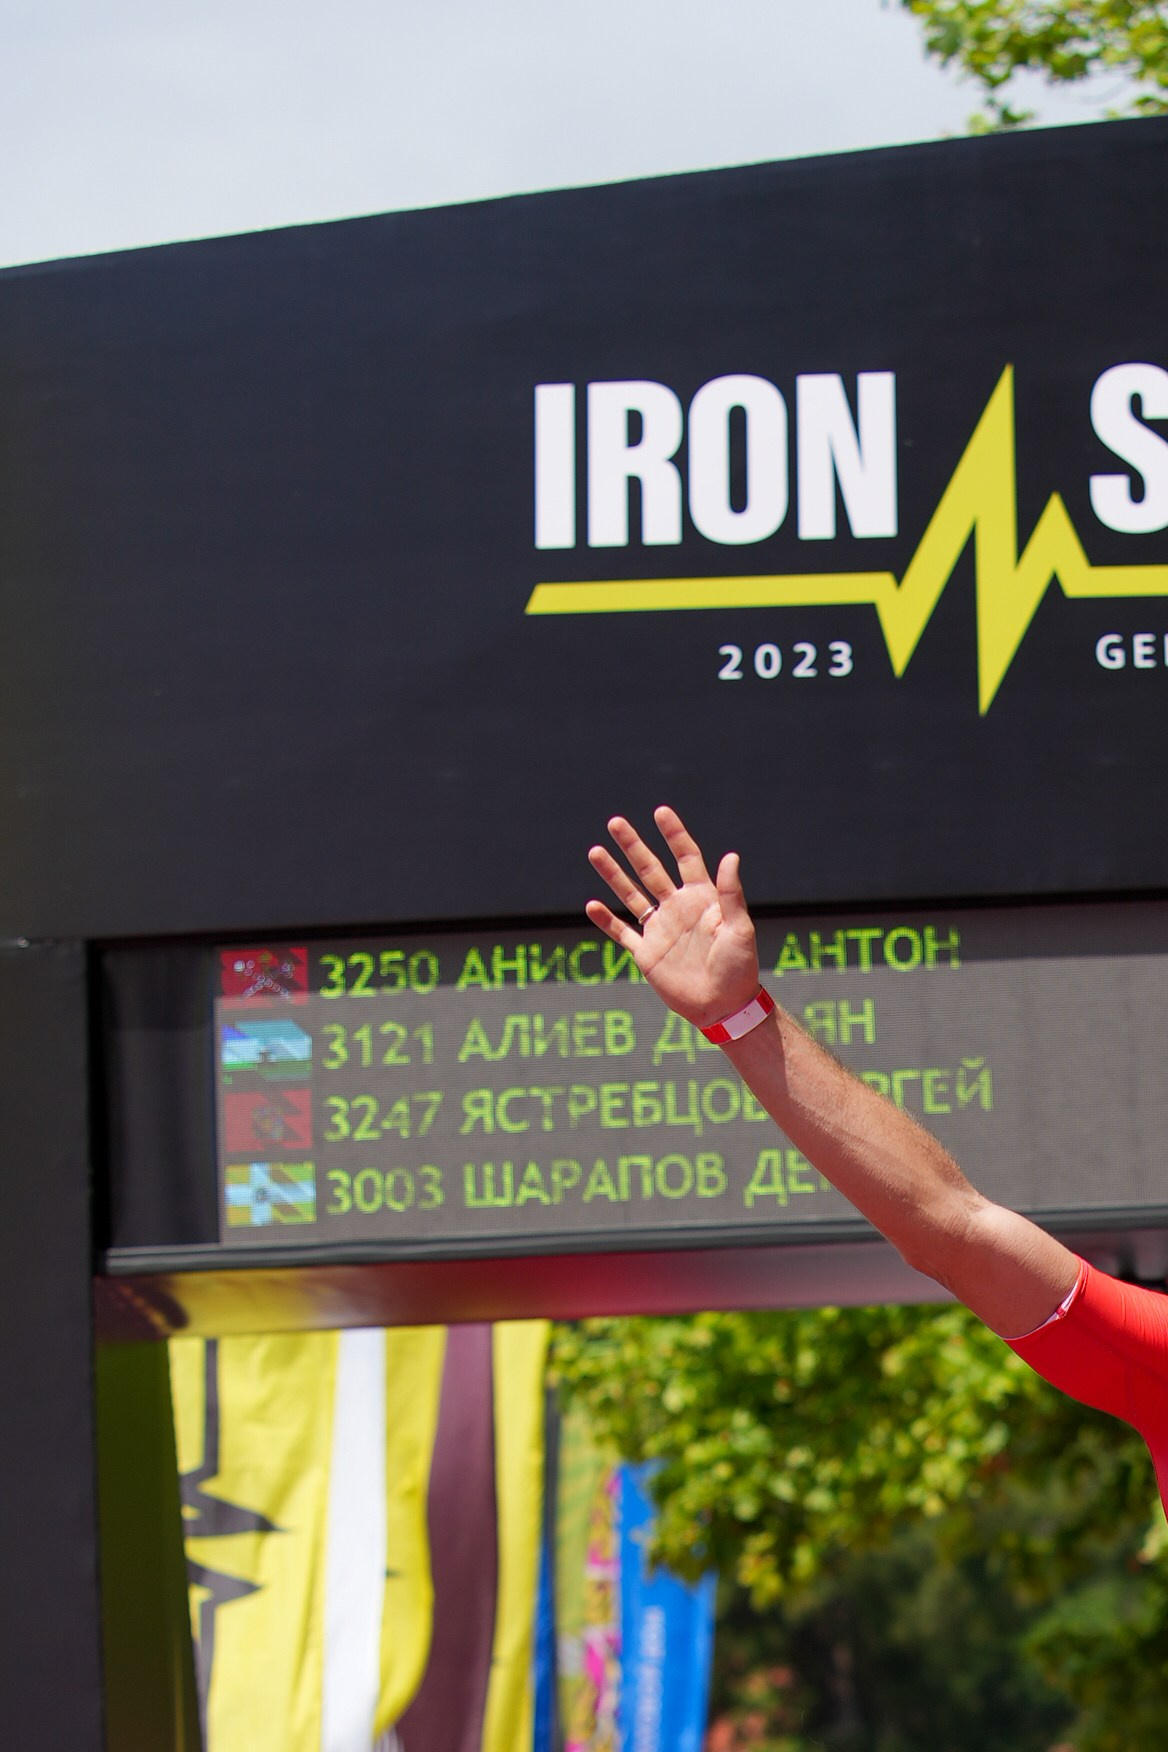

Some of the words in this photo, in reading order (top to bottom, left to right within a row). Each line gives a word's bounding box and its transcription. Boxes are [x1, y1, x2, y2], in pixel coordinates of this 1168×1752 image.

[535, 371, 898, 550] IRON
[718, 641, 854, 681] 2023
[320, 950, 440, 1000] 3250
[456, 938, 648, 992] АНИСИ
[773, 925, 961, 979] АНТОН
[323, 1021, 434, 1071] 3121
[458, 1010, 637, 1063] АЛИЕВ
[325, 1091, 444, 1142] 3247
[326, 1164, 446, 1215] 3003
[463, 1151, 729, 1210] ШАРАПОВ
